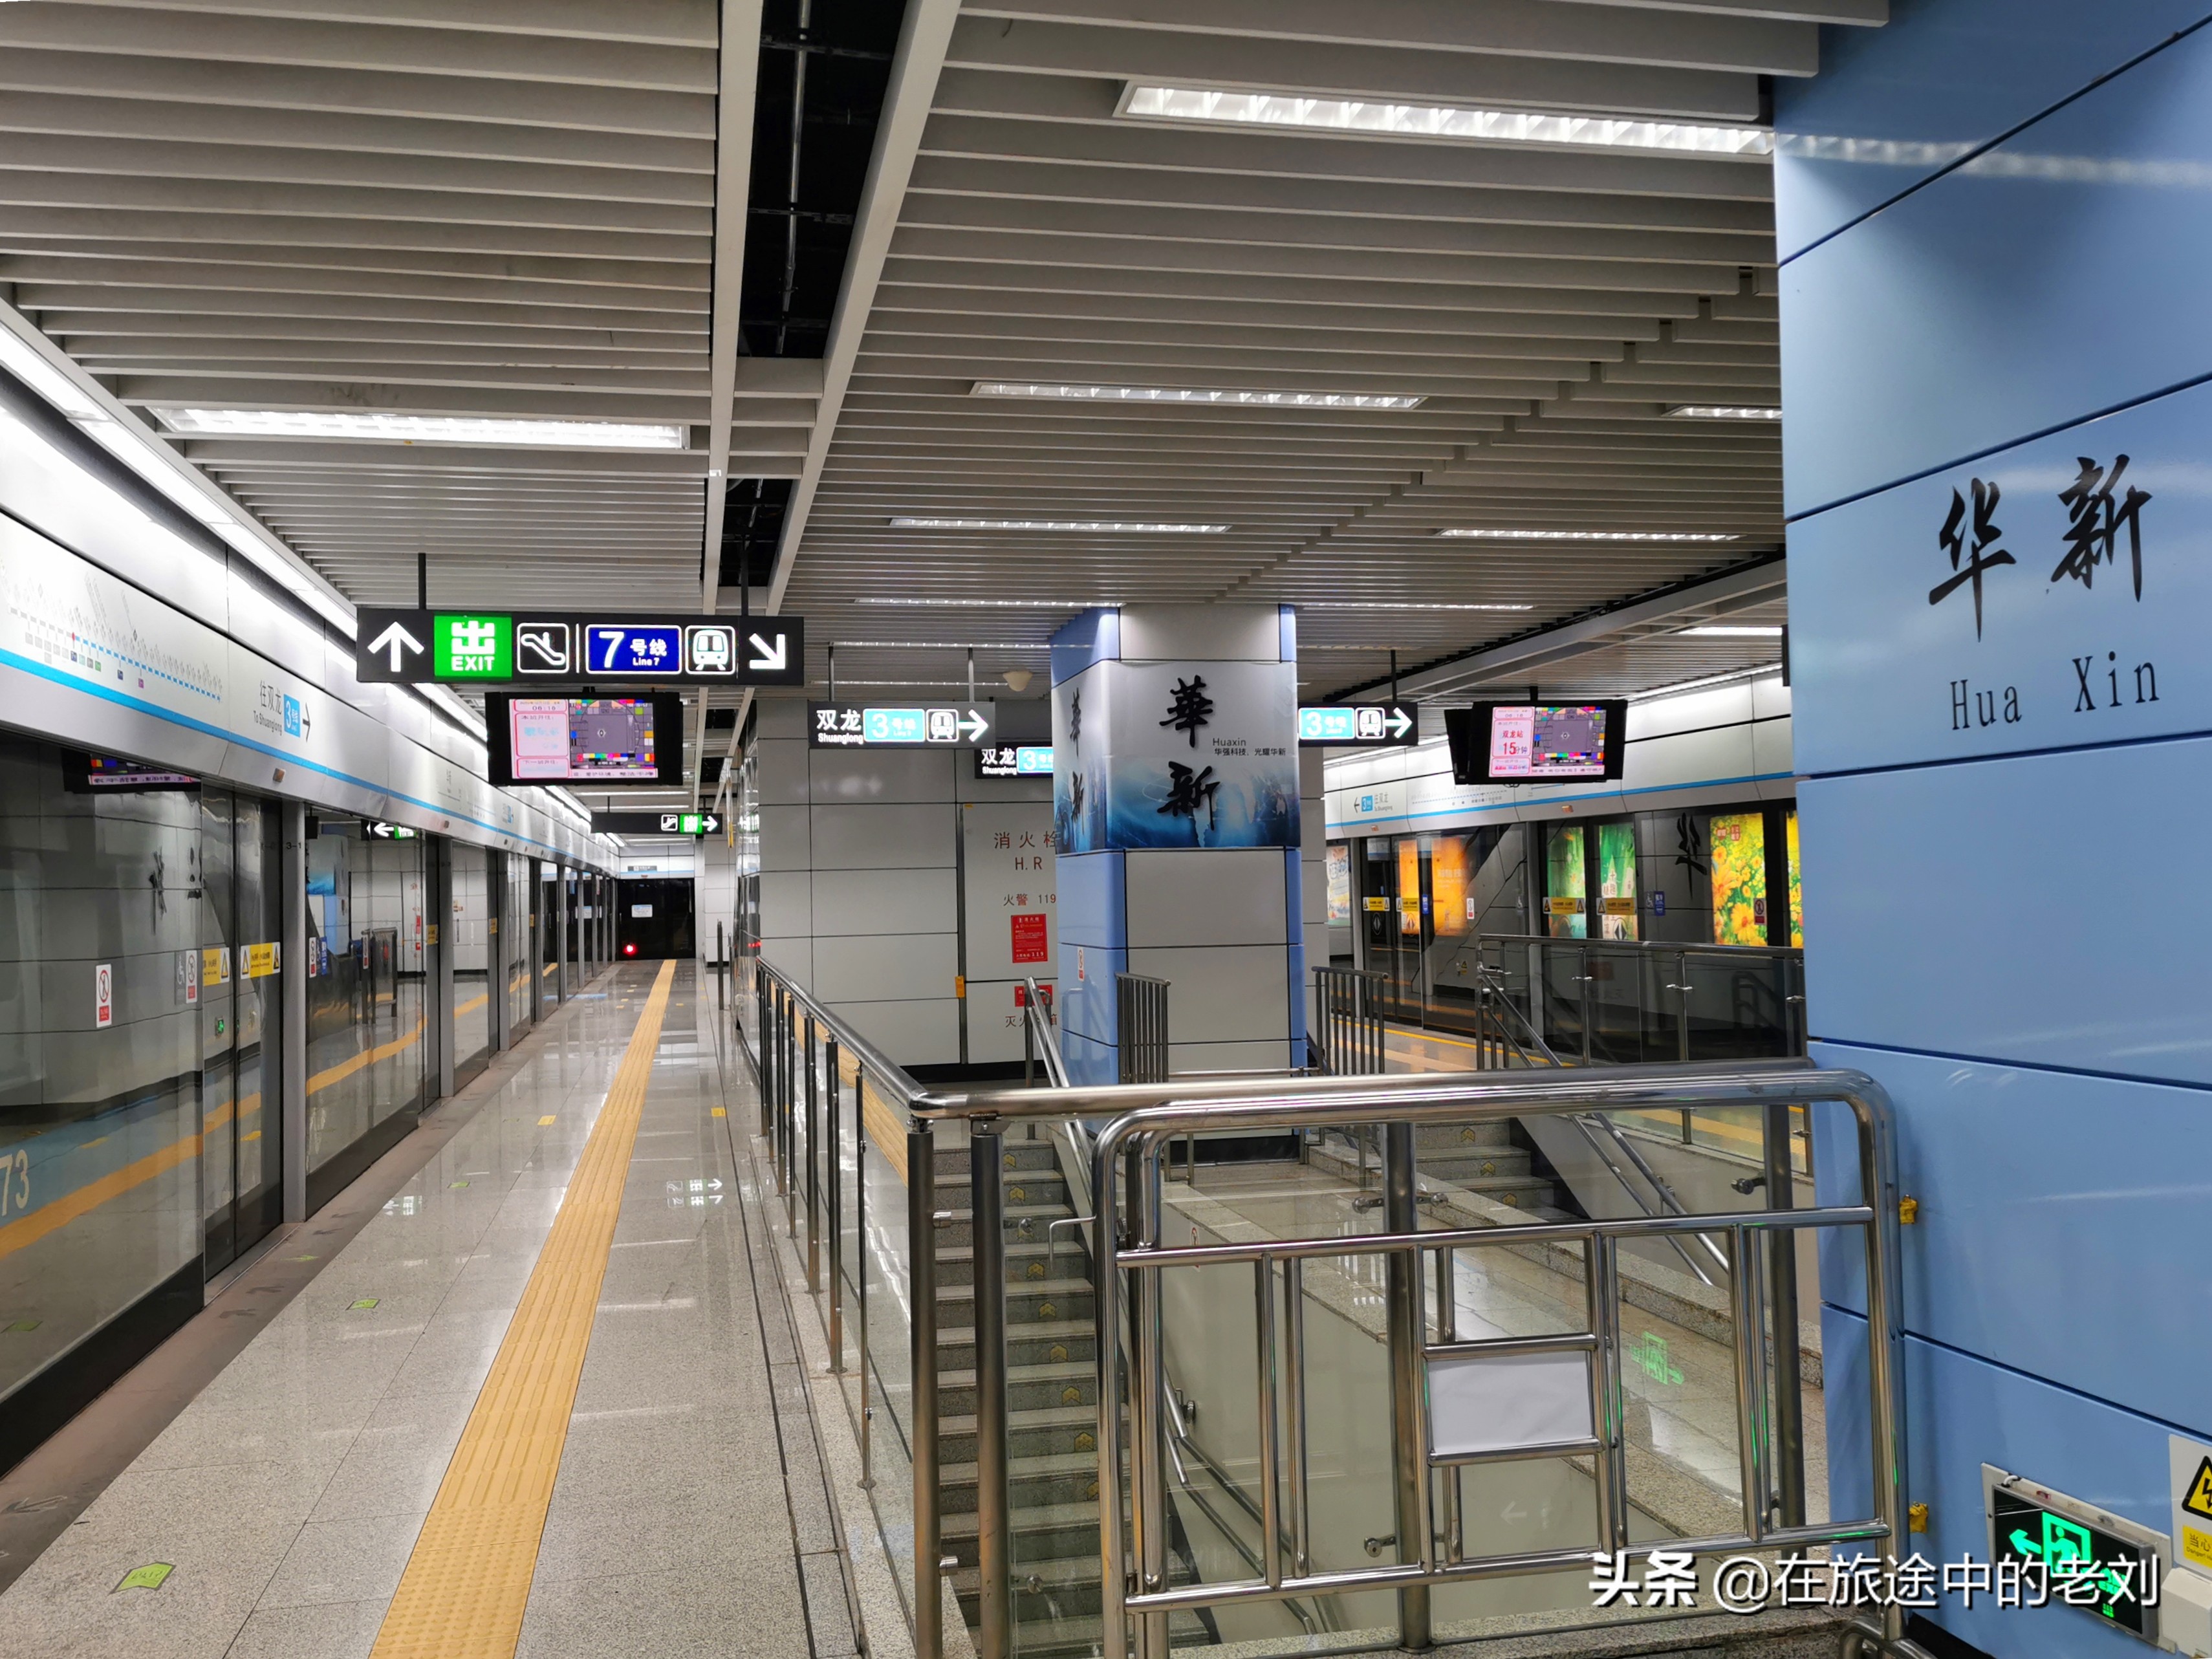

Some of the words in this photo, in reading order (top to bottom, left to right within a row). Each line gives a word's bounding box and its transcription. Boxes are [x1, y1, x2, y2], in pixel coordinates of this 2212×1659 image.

[1929, 454, 2152, 642] 华新
[451, 621, 495, 655] 出
[630, 639, 667, 656] 号线
[598, 631, 625, 668] 7
[451, 656, 495, 671] EXIT
[633, 658, 652, 666] Line
[654, 658, 660, 666] 7
[260, 680, 282, 715] 往双龙
[1951, 679, 2022, 730] Hua
[2072, 651, 2160, 712] Xin
[286, 700, 292, 728] 3
[816, 709, 862, 731] 双龙
[1306, 711, 1322, 736] 3
[872, 713, 889, 738] 3
[818, 733, 863, 744] Shuanglong
[1213, 737, 1246, 746] Huaxin
[981, 748, 1015, 764] 双龙
[1023, 750, 1036, 770] 3
[982, 766, 1017, 775] Shuanglong
[286, 841, 301, 850] 3-1
[1003, 893, 1028, 906] 火警
[1038, 893, 1056, 904] 119
[2189, 1533, 2211, 1552] 当心
